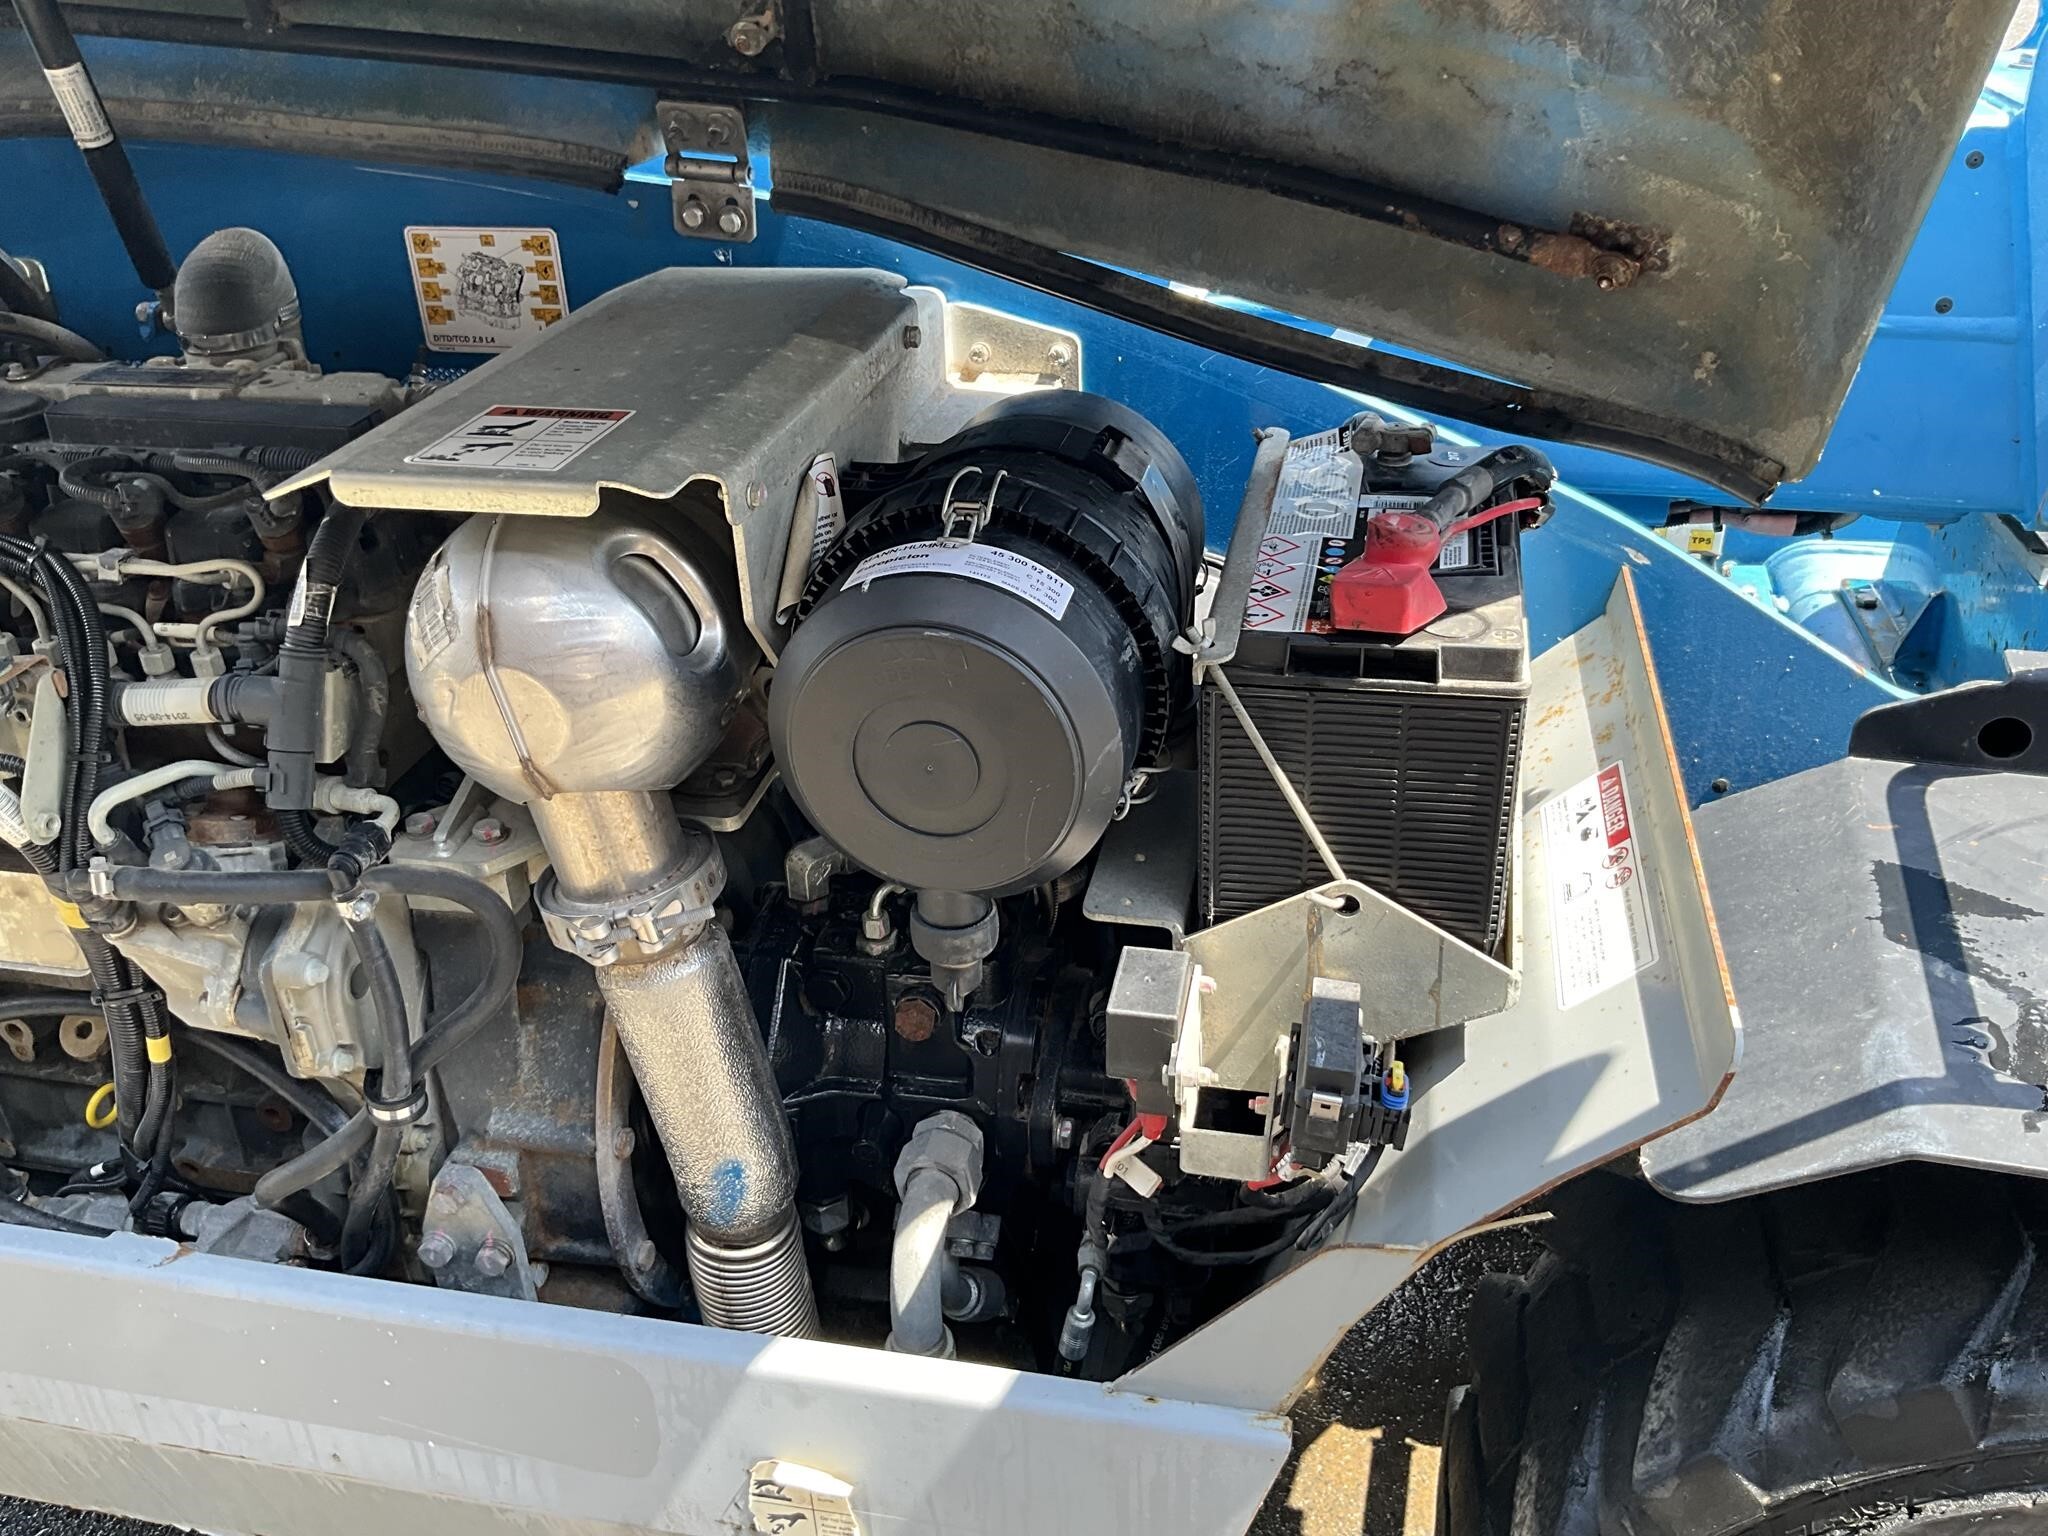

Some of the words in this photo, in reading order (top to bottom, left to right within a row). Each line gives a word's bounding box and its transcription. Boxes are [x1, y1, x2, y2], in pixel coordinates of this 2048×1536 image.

[520, 409, 613, 420] WARNING
[818, 521, 835, 530] energy
[990, 550, 1005, 558] 45
[1008, 555, 1028, 567] 300
[1031, 565, 1044, 575] 92
[1046, 573, 1064, 588] 911
[1603, 786, 1625, 836] DANGER
